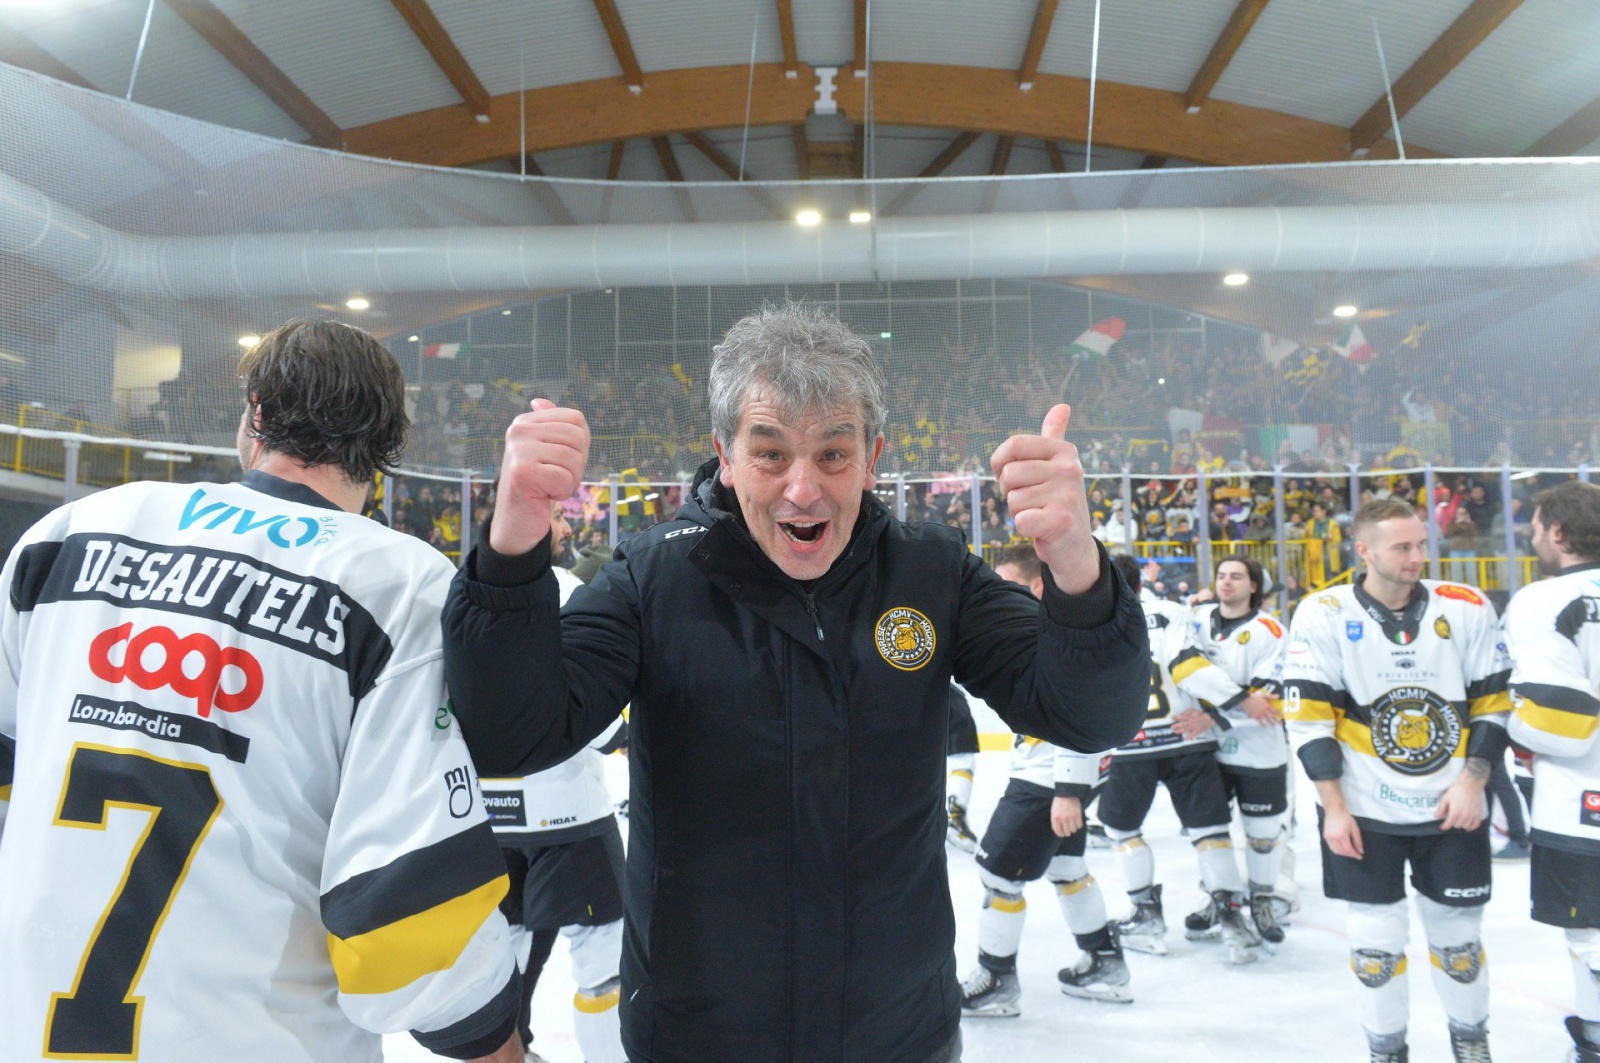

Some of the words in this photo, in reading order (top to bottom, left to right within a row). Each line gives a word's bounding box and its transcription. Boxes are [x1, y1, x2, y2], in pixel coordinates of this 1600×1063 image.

[178, 488, 320, 549] VIVO
[72, 539, 351, 656] DESAUTELS
[889, 610, 911, 620] HCMV
[920, 620, 933, 652] HOCKEY
[88, 621, 264, 719] coop
[1283, 685, 1301, 713] 19
[1388, 687, 1429, 702] HCMV
[71, 698, 182, 739] Lombardia
[1439, 703, 1461, 755] HOCKEY
[482, 796, 520, 807] ovauto
[549, 816, 577, 825] HOAX
[42, 743, 224, 1060] 7
[1444, 884, 1491, 899] CCM
